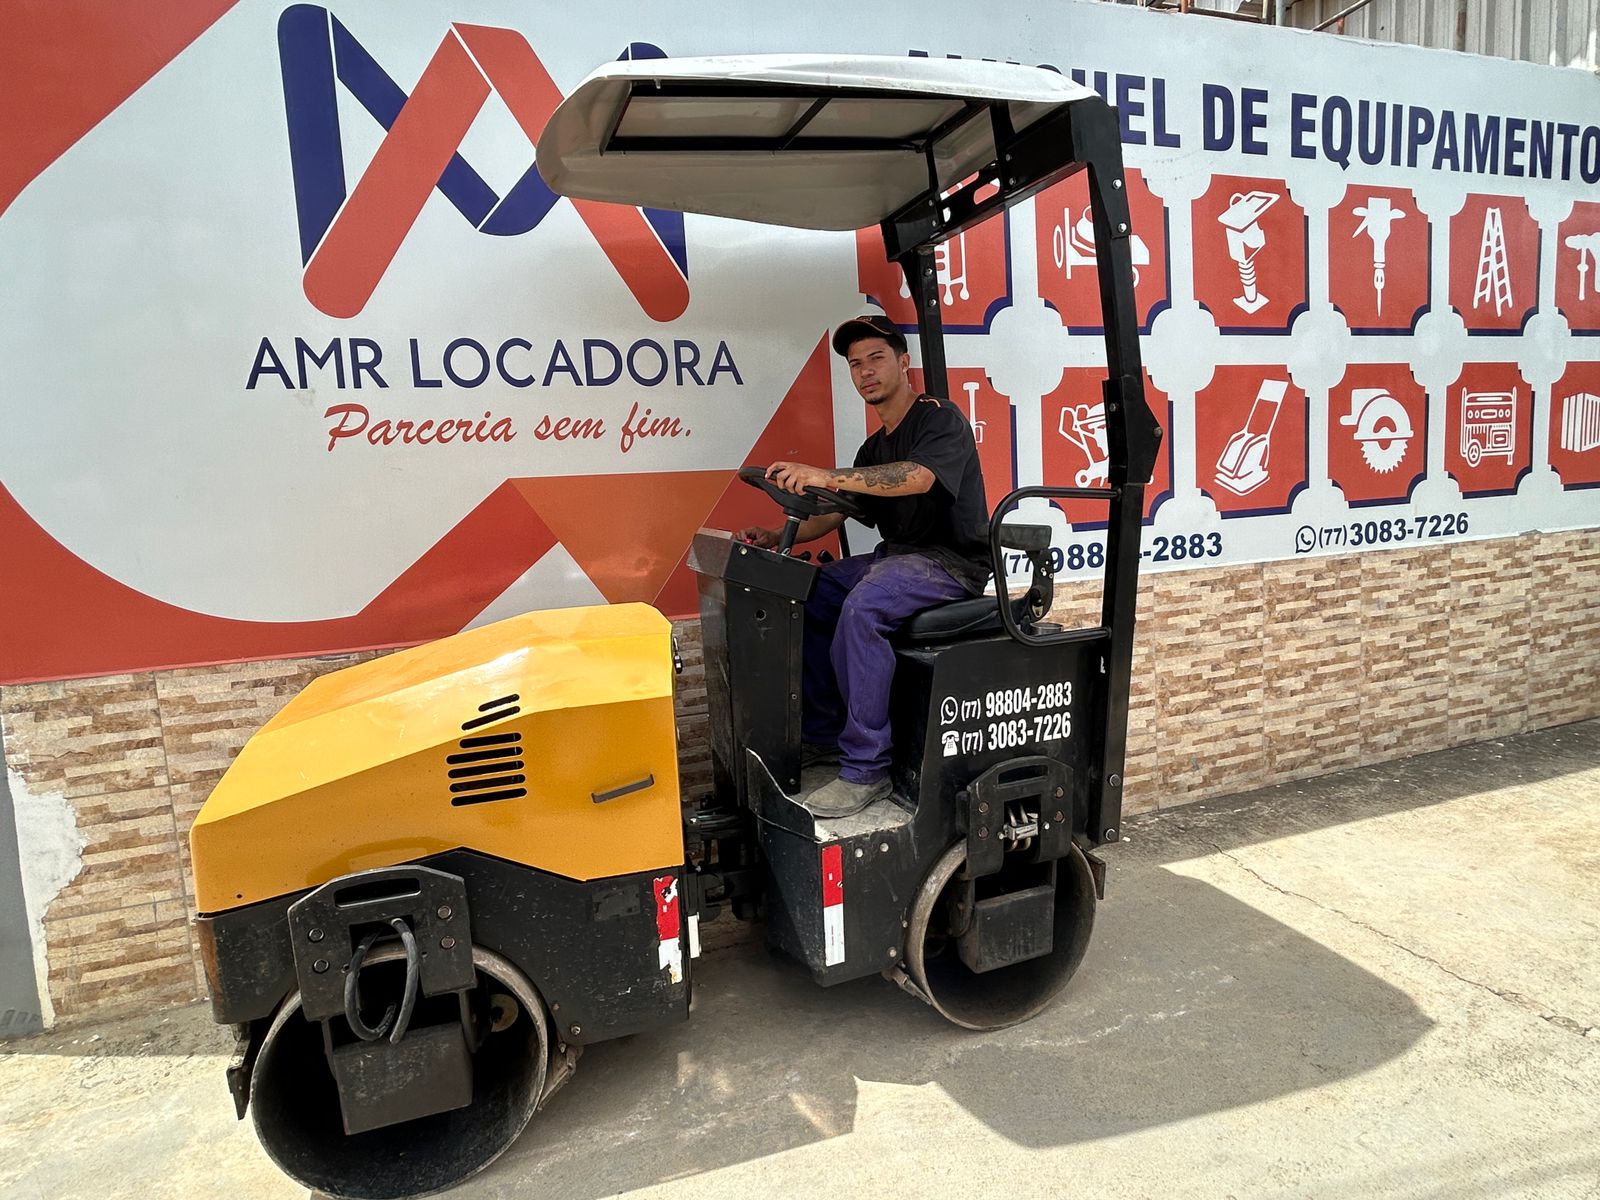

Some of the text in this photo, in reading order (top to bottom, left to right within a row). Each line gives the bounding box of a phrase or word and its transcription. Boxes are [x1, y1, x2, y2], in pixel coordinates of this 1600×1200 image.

[1203, 83, 1268, 155] DE
[1291, 93, 1600, 184] EQUIPAMENTO
[245, 336, 744, 390] AMR LOCADORA
[324, 401, 691, 453] Parceria sem fim.
[1318, 512, 1469, 548] (77) 3083-7226
[961, 681, 1072, 721] (77) 98804-2883
[962, 711, 1072, 754] (77) 3083-7226
